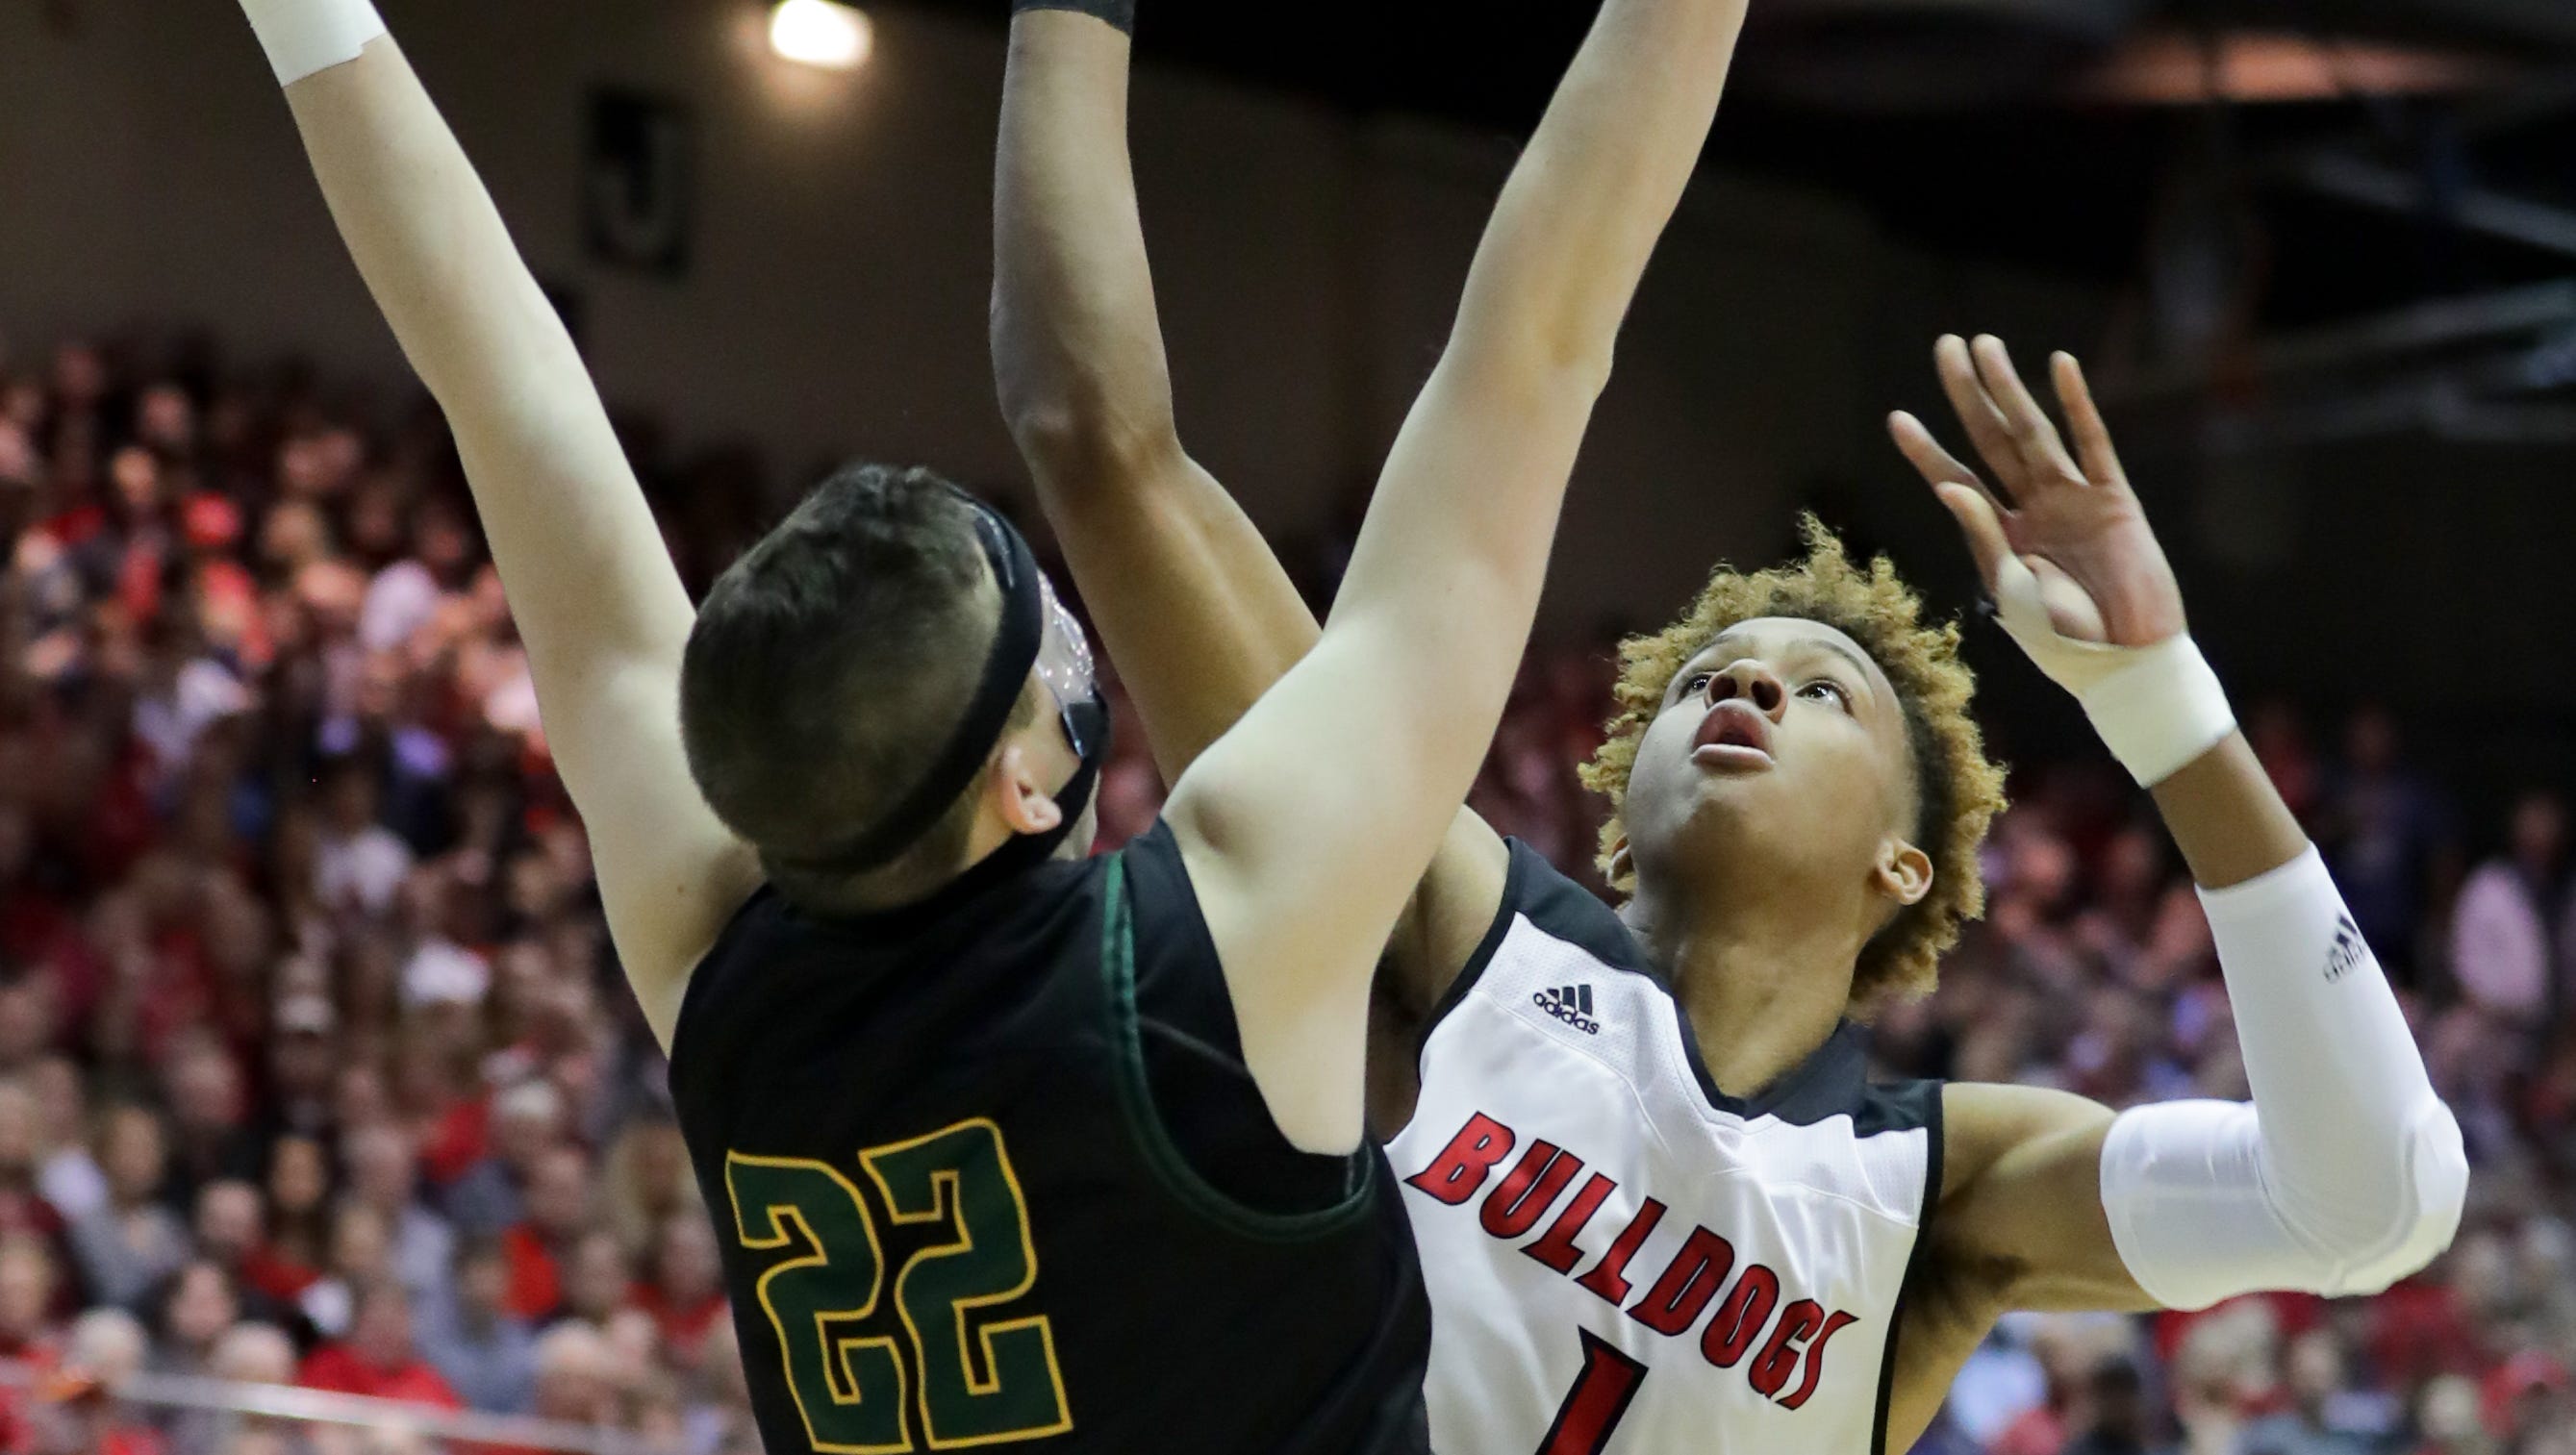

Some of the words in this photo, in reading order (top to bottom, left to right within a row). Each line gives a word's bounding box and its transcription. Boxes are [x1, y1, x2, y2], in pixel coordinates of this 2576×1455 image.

[587, 113, 680, 256] J
[1532, 992, 1600, 1035] adidas
[725, 1116, 1073, 1453] 22
[1403, 1111, 1859, 1411] BULLDOGS
